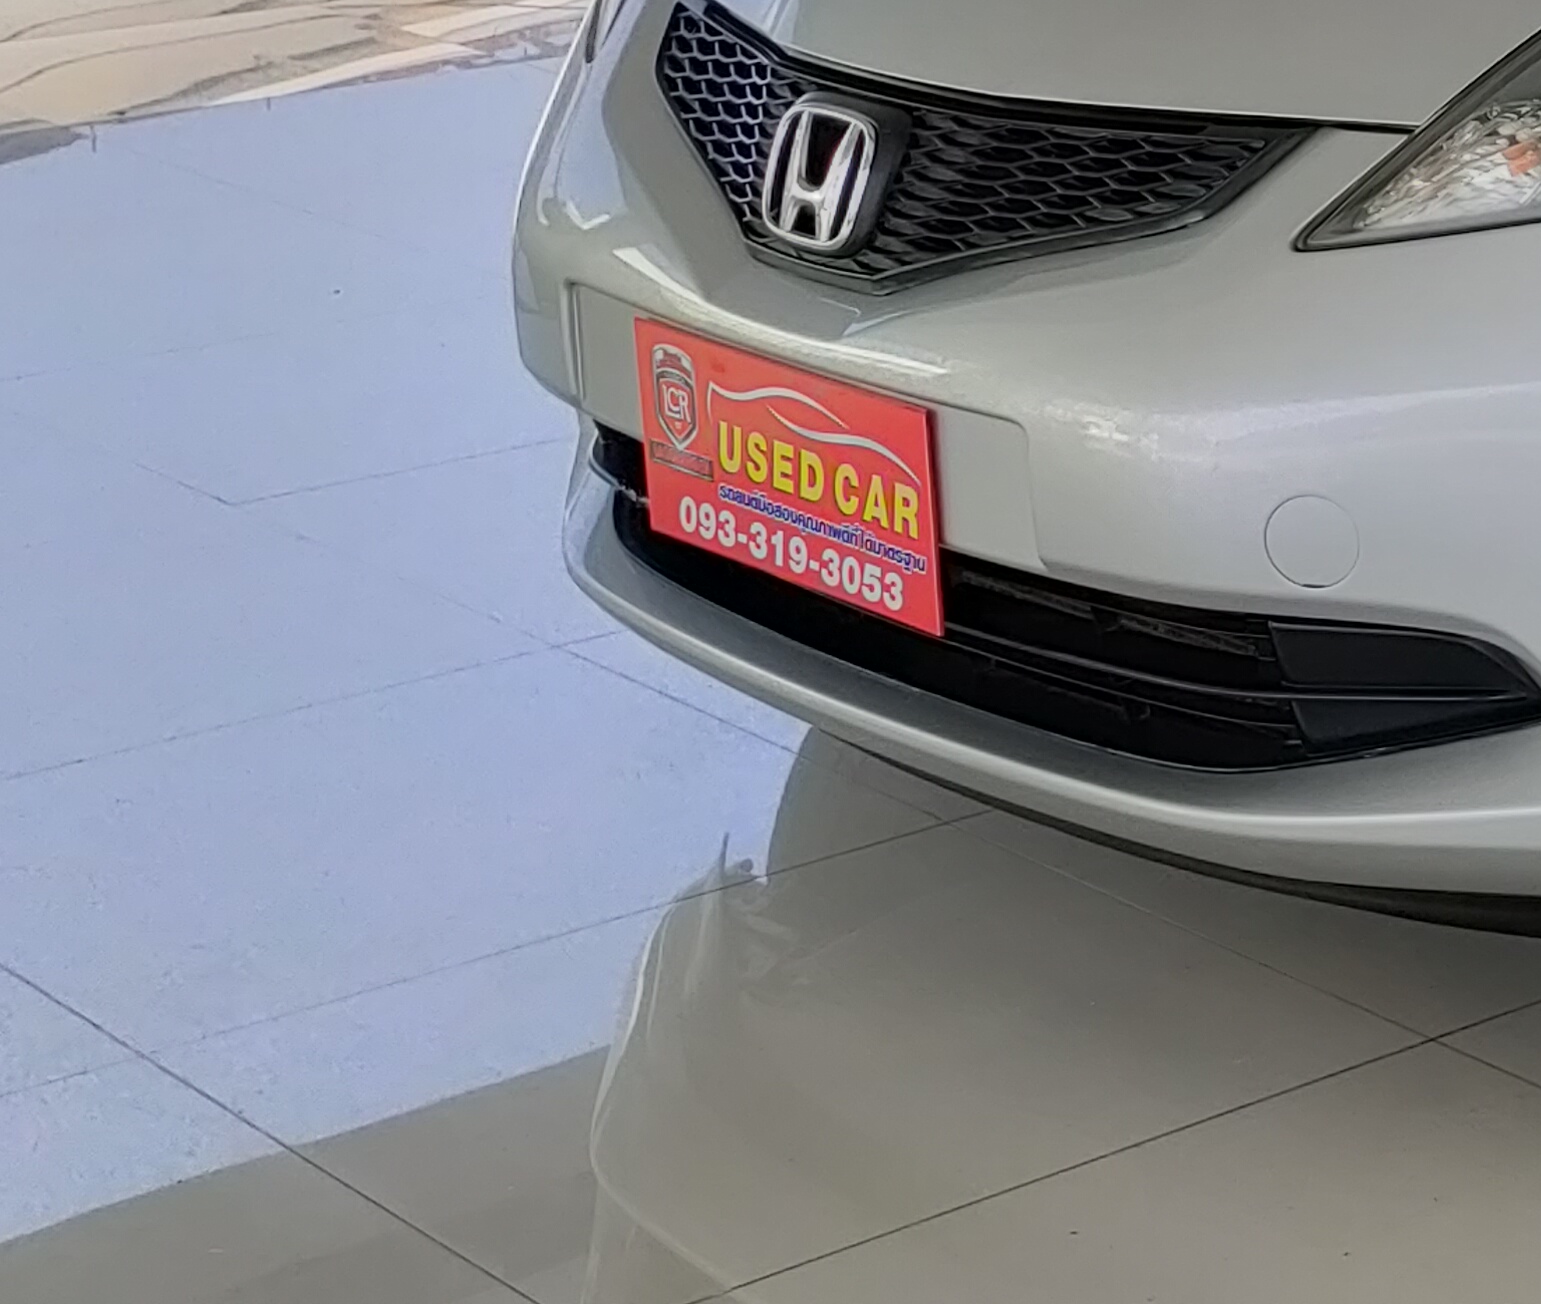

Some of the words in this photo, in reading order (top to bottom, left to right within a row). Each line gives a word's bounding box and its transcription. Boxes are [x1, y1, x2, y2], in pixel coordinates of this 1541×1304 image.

[717, 420, 826, 504] USED
[834, 463, 920, 540] CAR
[678, 495, 905, 612] 093-319-3053
